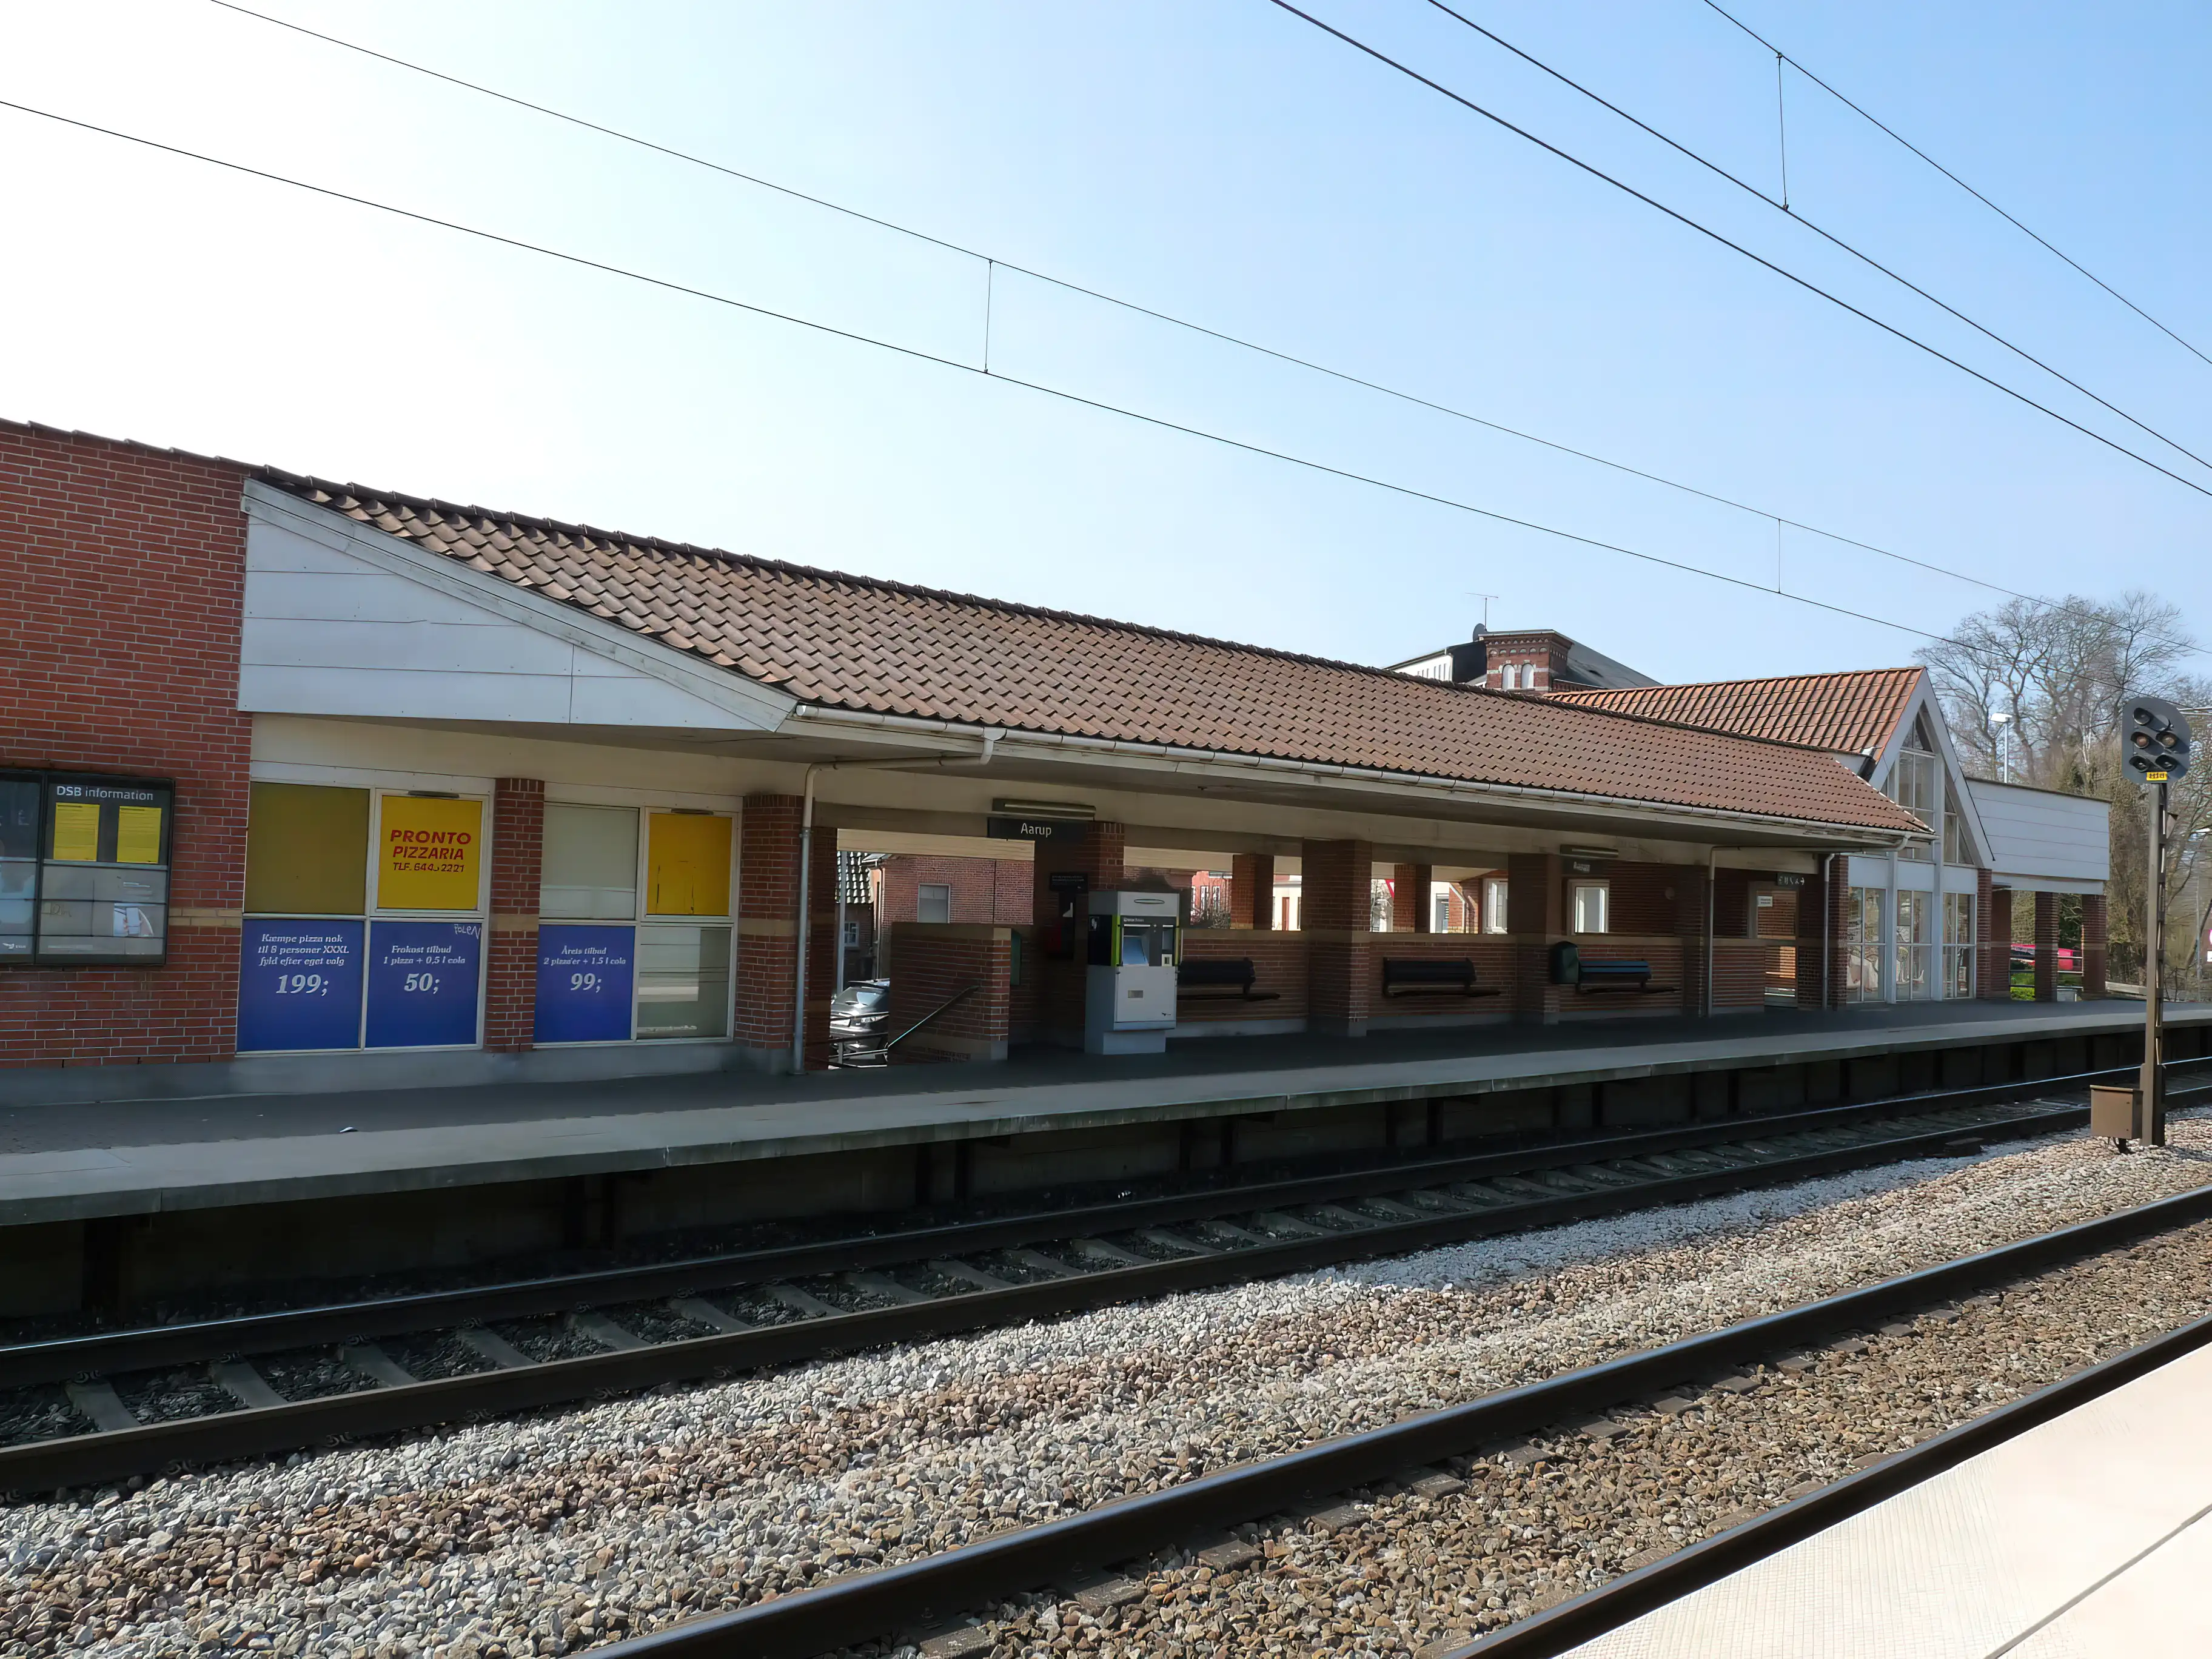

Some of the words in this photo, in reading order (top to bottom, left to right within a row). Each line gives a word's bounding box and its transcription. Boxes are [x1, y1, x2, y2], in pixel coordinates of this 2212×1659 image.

[56, 786, 82, 797] DSB
[85, 787, 153, 800] information
[390, 830, 471, 845] PRONTO
[1021, 823, 1052, 838] Aarup
[393, 846, 464, 860] PIZZARIA
[261, 934, 297, 943] Kæmpe
[299, 934, 323, 943] pizza
[323, 945, 349, 954] XXXL
[561, 945, 583, 954] Årets
[259, 956, 278, 966] fyld
[280, 956, 302, 966] efter
[326, 957, 344, 966] valg
[390, 957, 414, 966] pizza
[426, 956, 440, 965] 0,5
[276, 974, 329, 996] 199;
[404, 973, 440, 994] 50;
[570, 973, 602, 993] 99;
